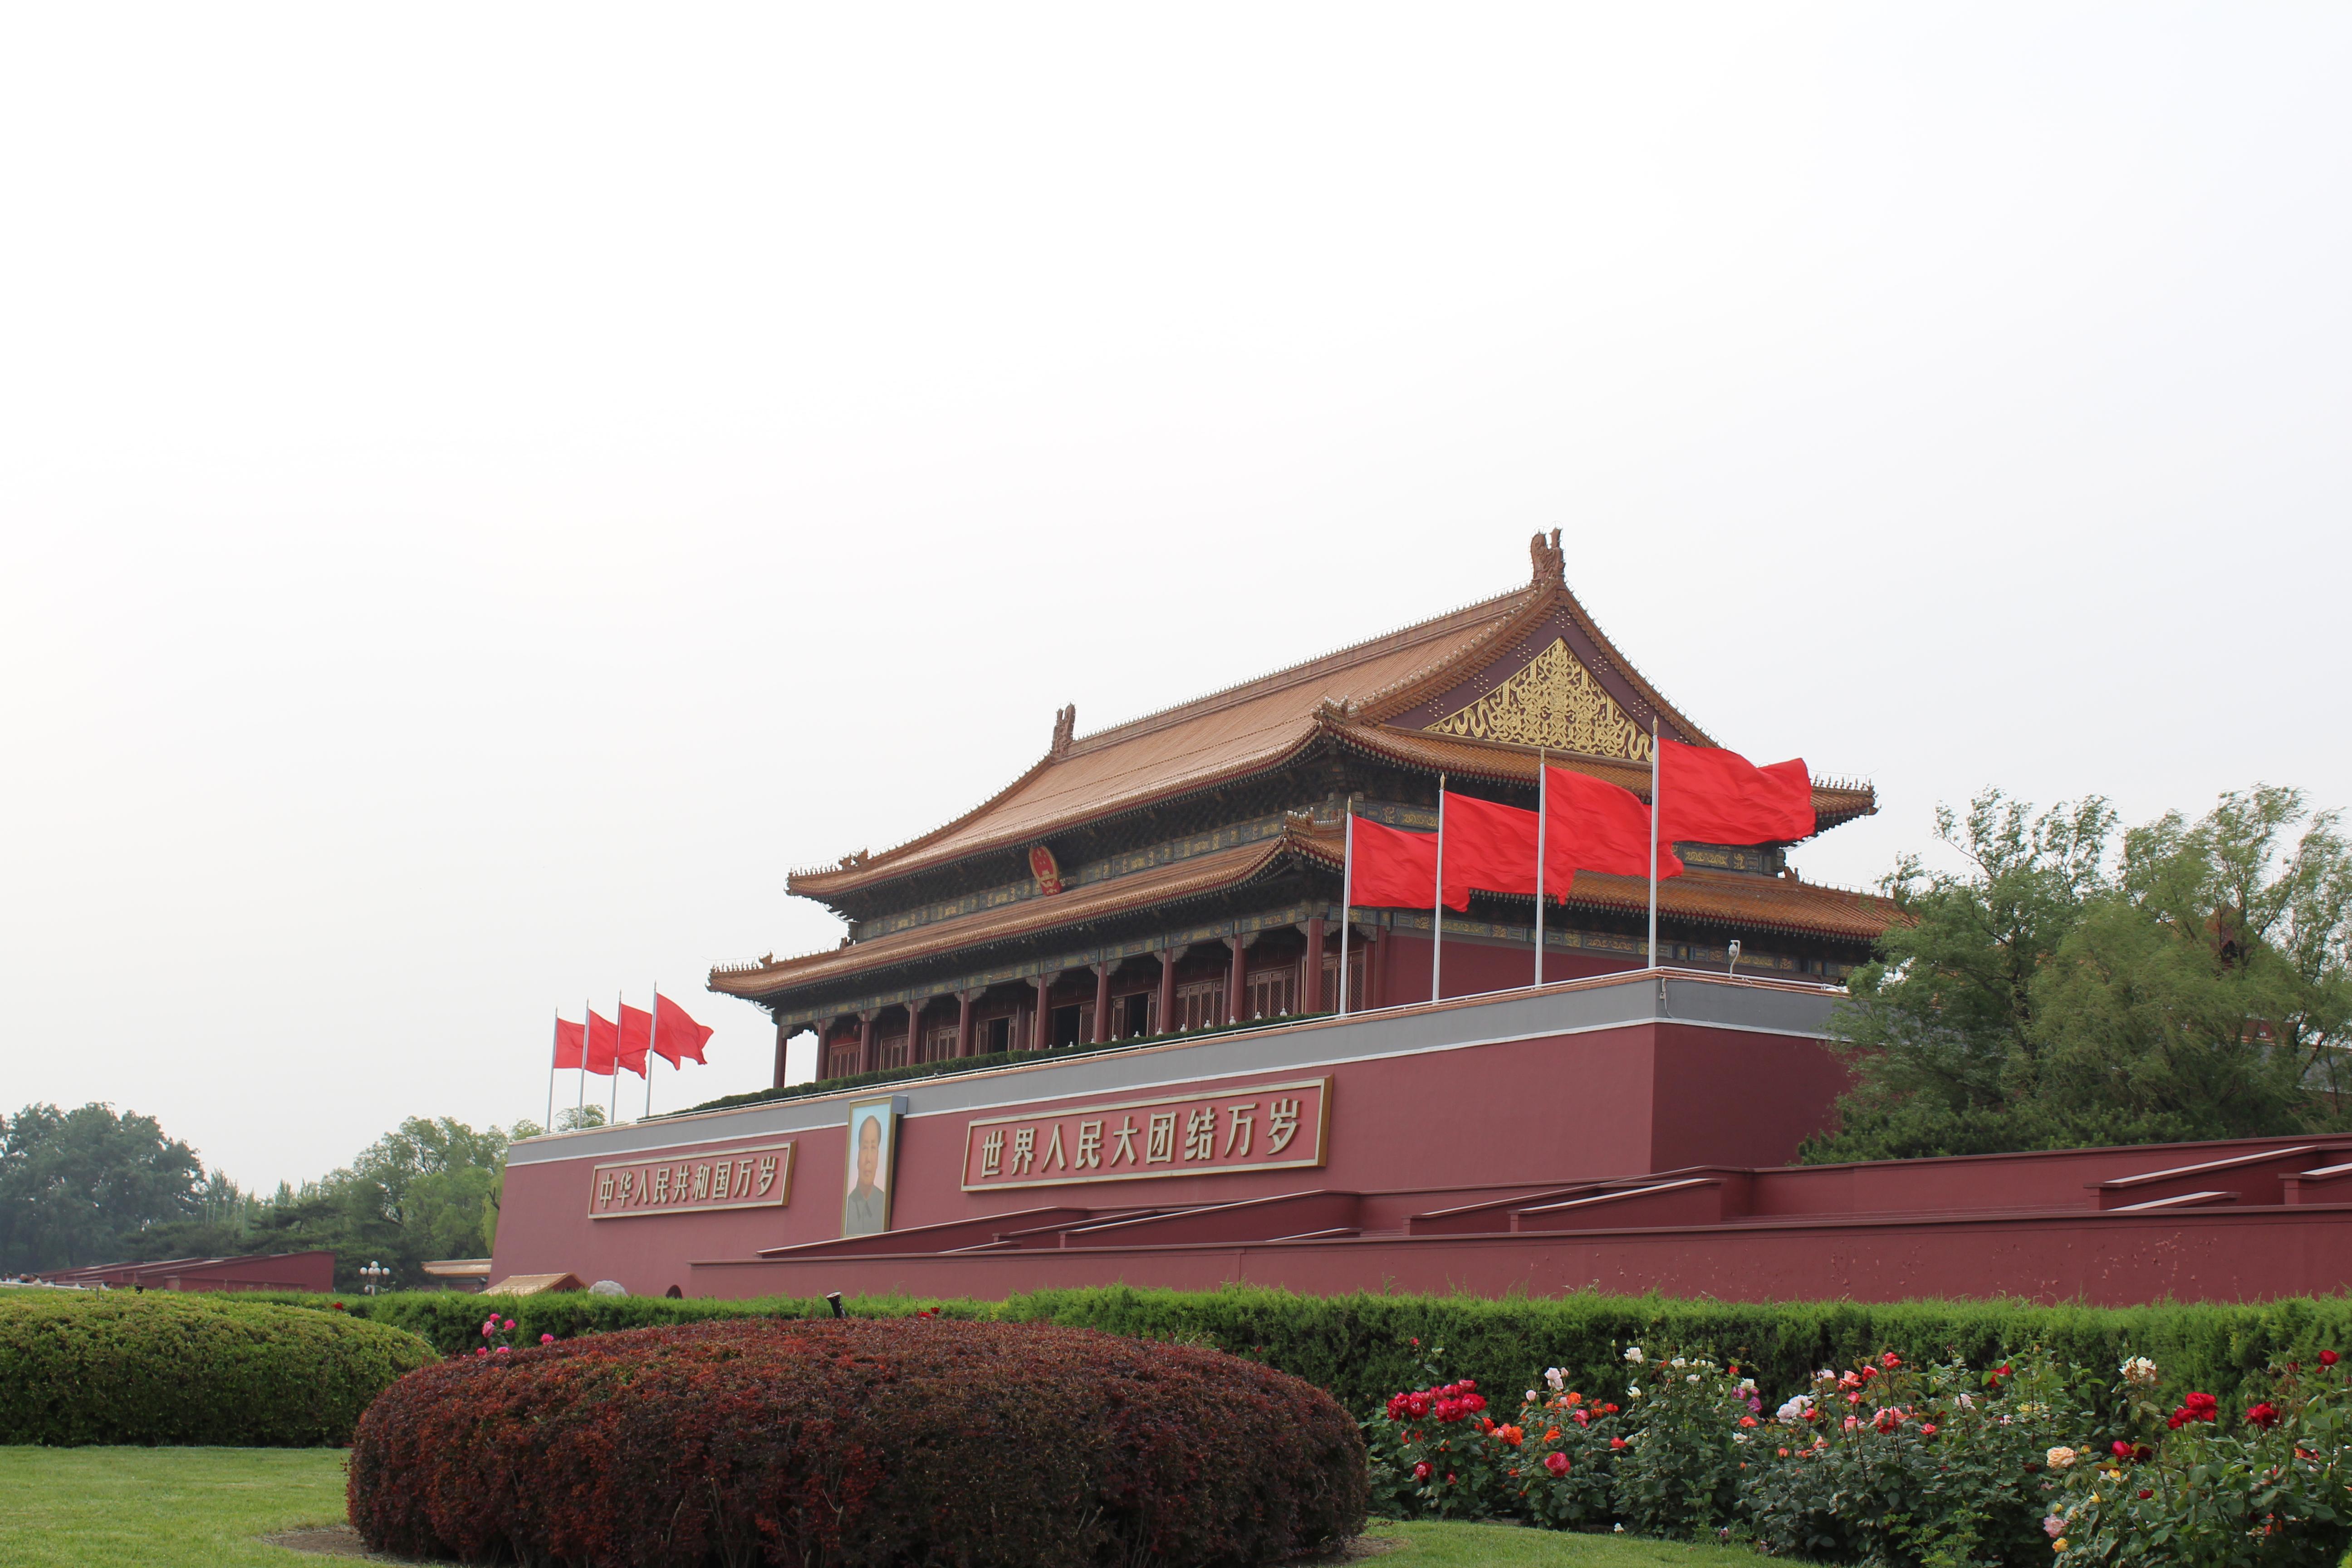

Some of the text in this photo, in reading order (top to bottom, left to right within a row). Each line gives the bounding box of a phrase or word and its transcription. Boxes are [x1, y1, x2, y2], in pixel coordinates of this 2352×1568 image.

[981, 1098, 1300, 1177] 世界人民大团结万岁
[599, 1156, 777, 1208] 中华人民共和国万岁
